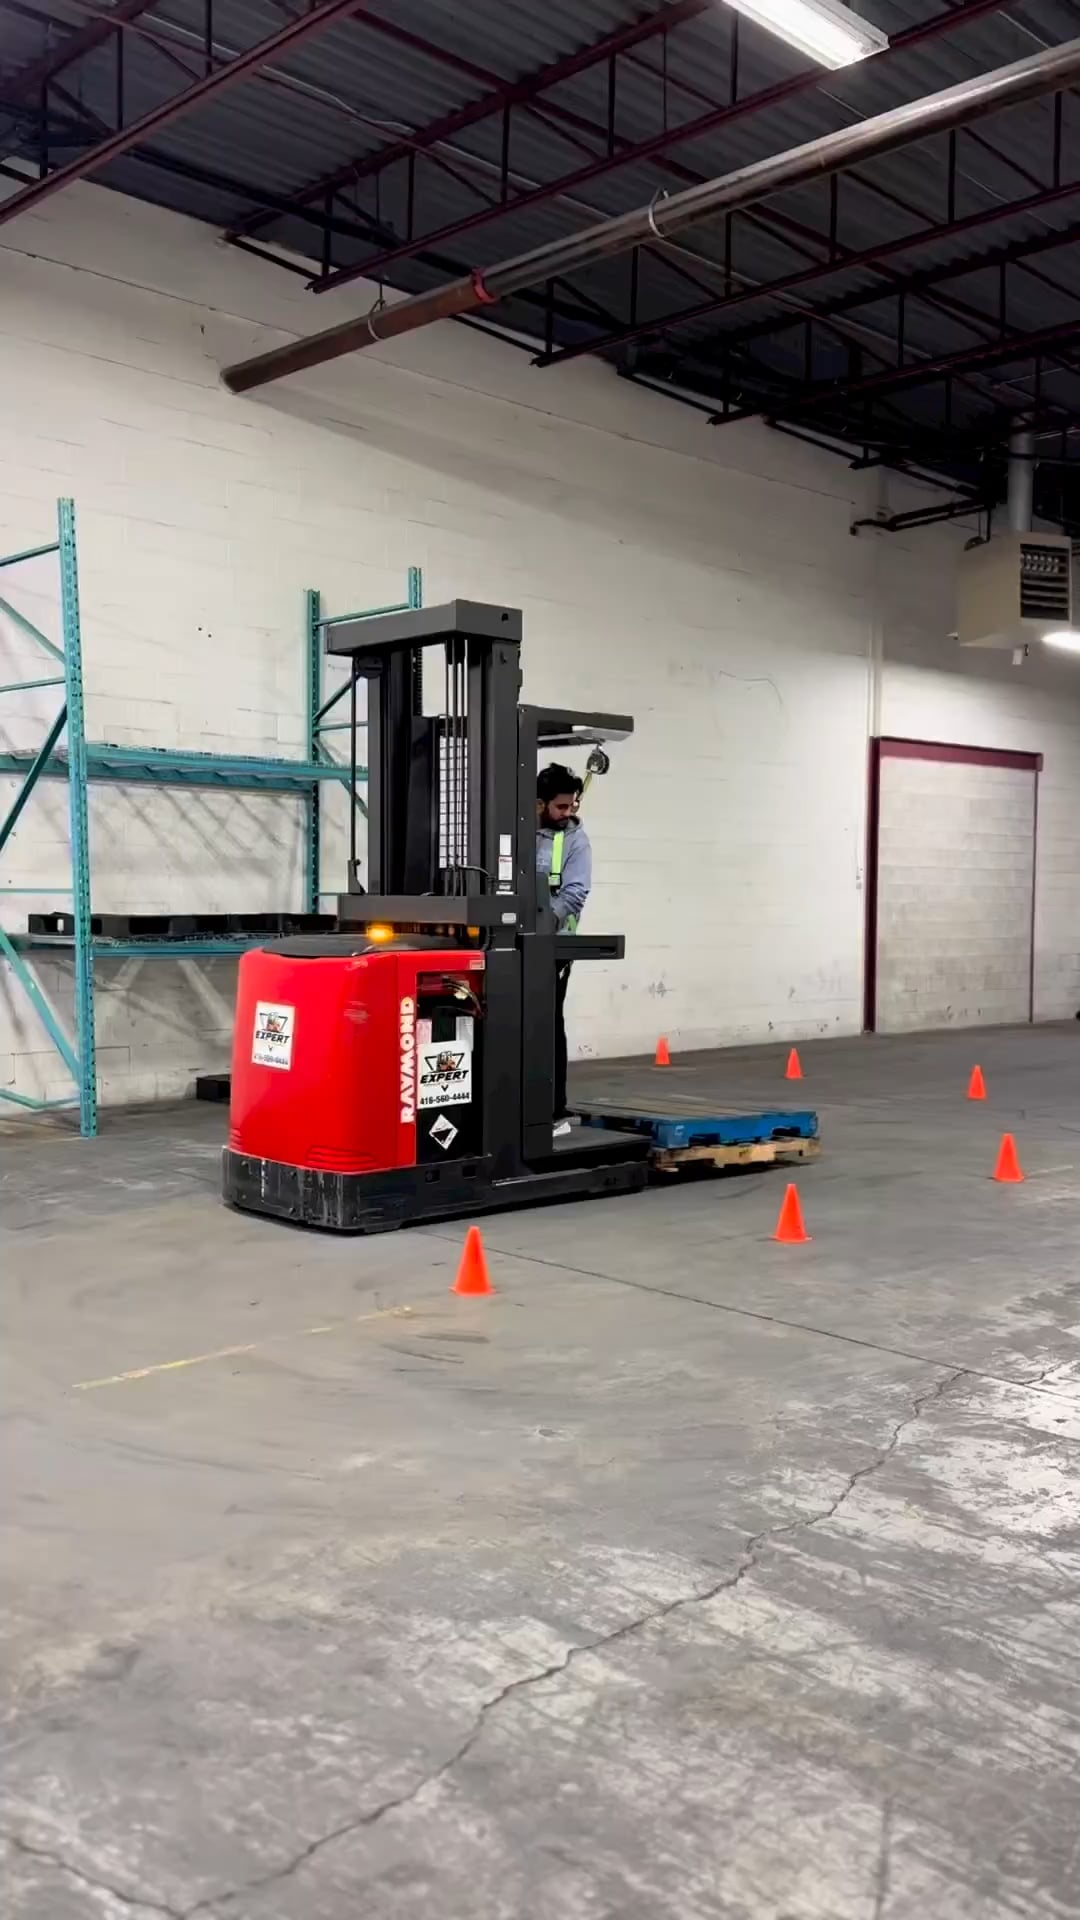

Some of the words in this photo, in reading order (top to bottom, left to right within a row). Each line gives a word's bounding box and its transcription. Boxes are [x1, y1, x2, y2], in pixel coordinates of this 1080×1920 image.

[256, 1031, 290, 1044] EXPERT
[400, 997, 415, 1124] RAYMOND
[420, 1070, 469, 1084] EXPERT
